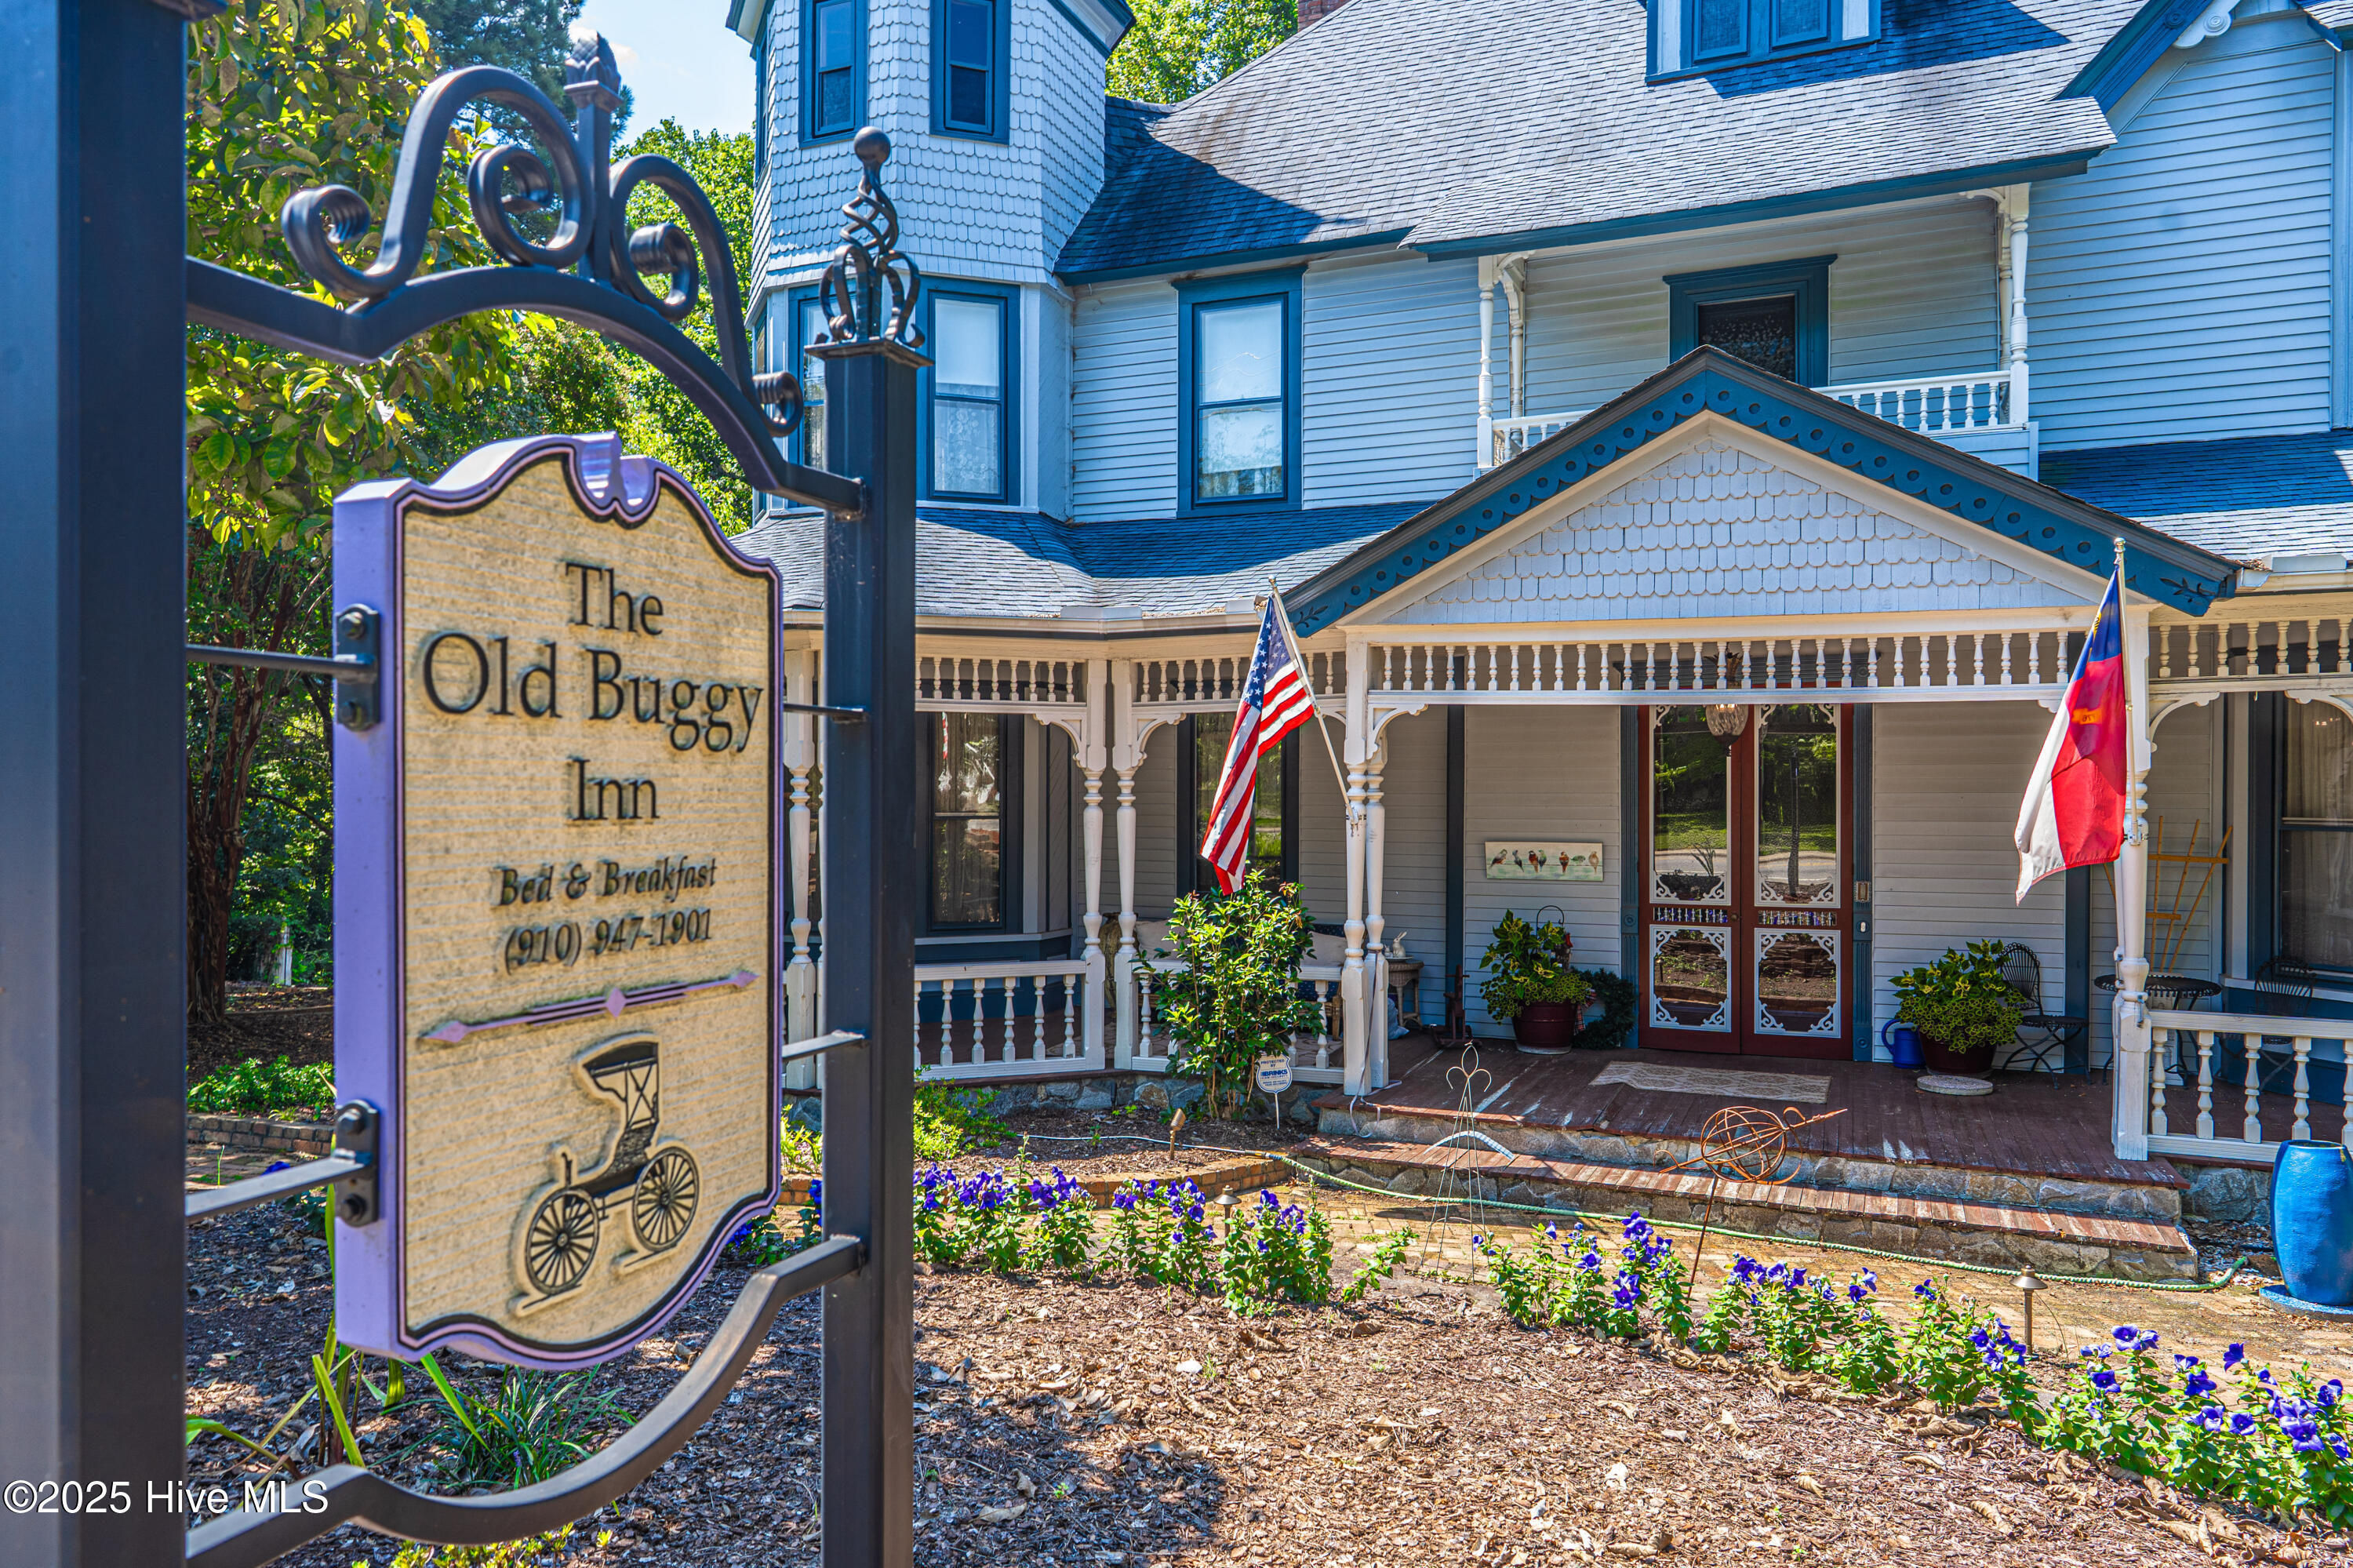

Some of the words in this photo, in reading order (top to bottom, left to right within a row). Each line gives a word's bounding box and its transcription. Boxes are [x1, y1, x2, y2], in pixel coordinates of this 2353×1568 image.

[565, 561, 664, 636] The
[423, 631, 563, 719] Old
[585, 647, 764, 753] Buggy
[570, 757, 660, 821] Inn
[500, 864, 554, 905] Bed
[566, 863, 591, 900] &
[603, 855, 717, 903] Breakfast
[505, 922, 582, 976] (910)
[590, 908, 711, 955] 947-1901
